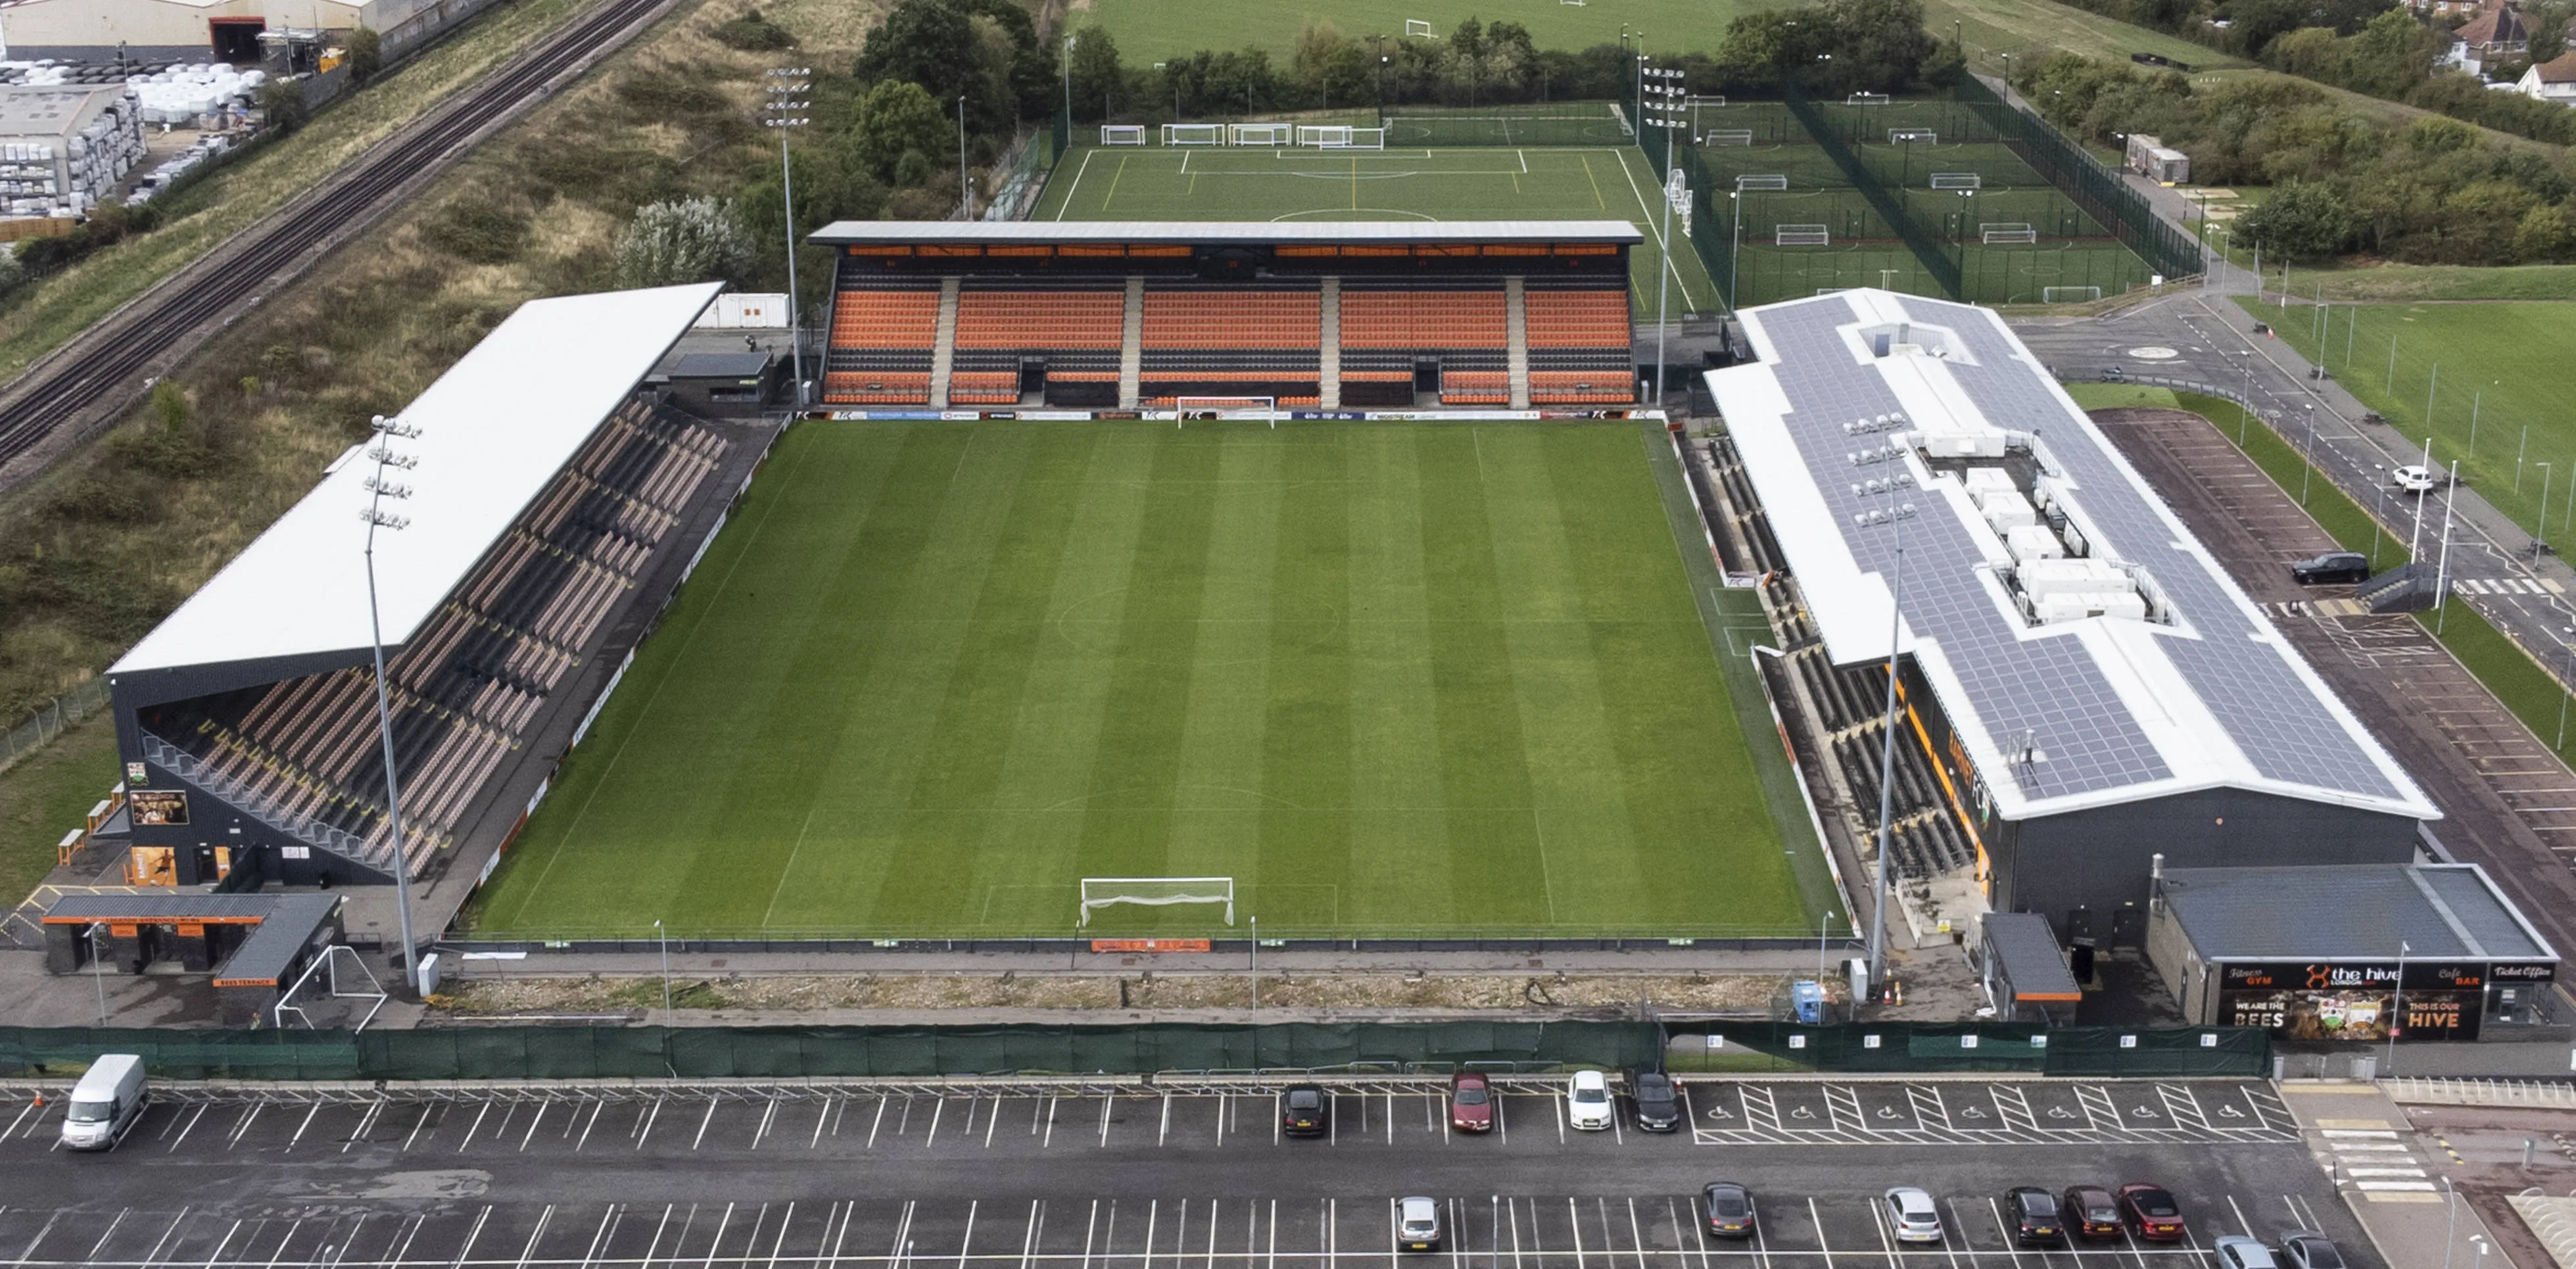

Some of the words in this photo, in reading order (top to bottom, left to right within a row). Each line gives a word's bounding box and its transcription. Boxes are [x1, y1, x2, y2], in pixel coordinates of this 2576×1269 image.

[2228, 968, 2262, 979] Fitness
[2332, 968, 2361, 980] the
[2366, 968, 2401, 980] hive
[2494, 967, 2521, 976] Ticket
[2523, 967, 2551, 978] Office
[2246, 976, 2272, 985] GYM
[2236, 1002, 2249, 1011] WE
[2250, 1002, 2267, 1011] ARE
[2269, 1001, 2285, 1011] THE
[2235, 1013, 2285, 1028] BEES
[2408, 1013, 2459, 1028] HIVE
